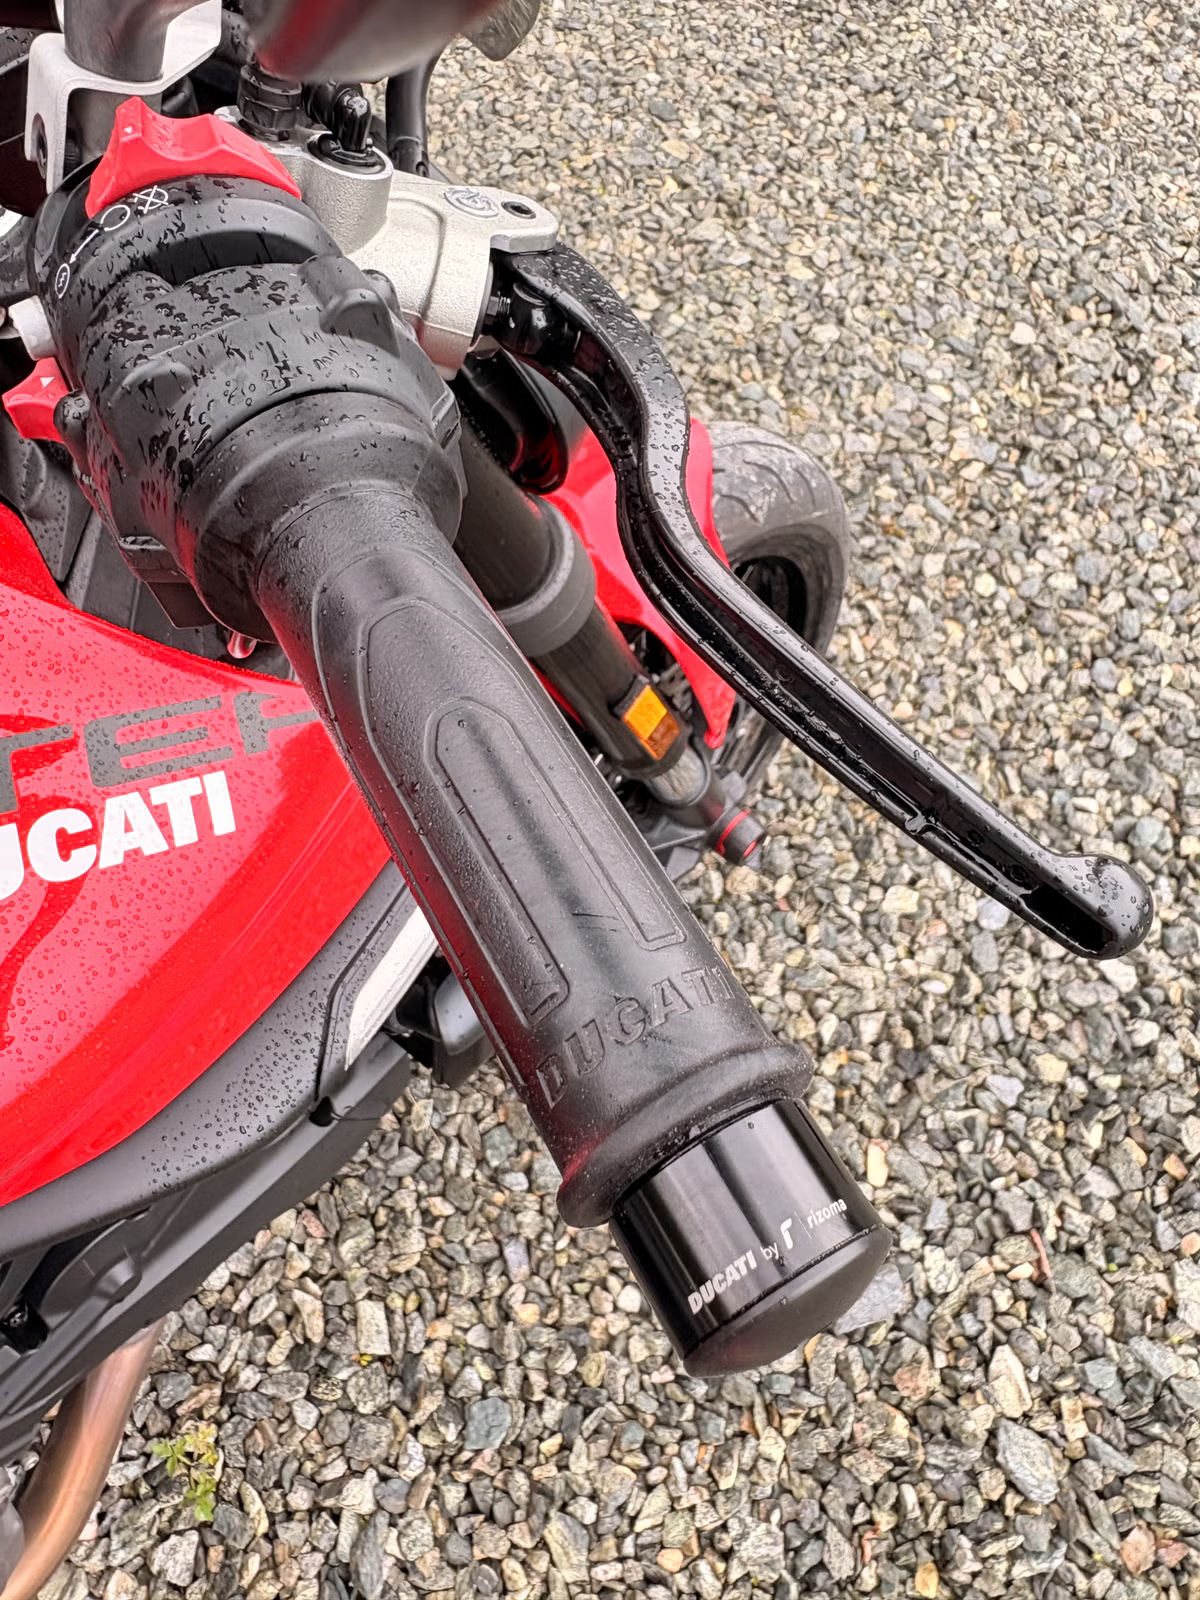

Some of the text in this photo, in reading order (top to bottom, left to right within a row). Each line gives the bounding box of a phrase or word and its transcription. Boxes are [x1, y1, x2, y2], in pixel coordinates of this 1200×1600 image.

[536, 966, 735, 1108] DUCATI
[687, 1249, 758, 1315] DUCATI
[760, 1241, 780, 1260] by
[807, 1198, 848, 1229] rizoma
